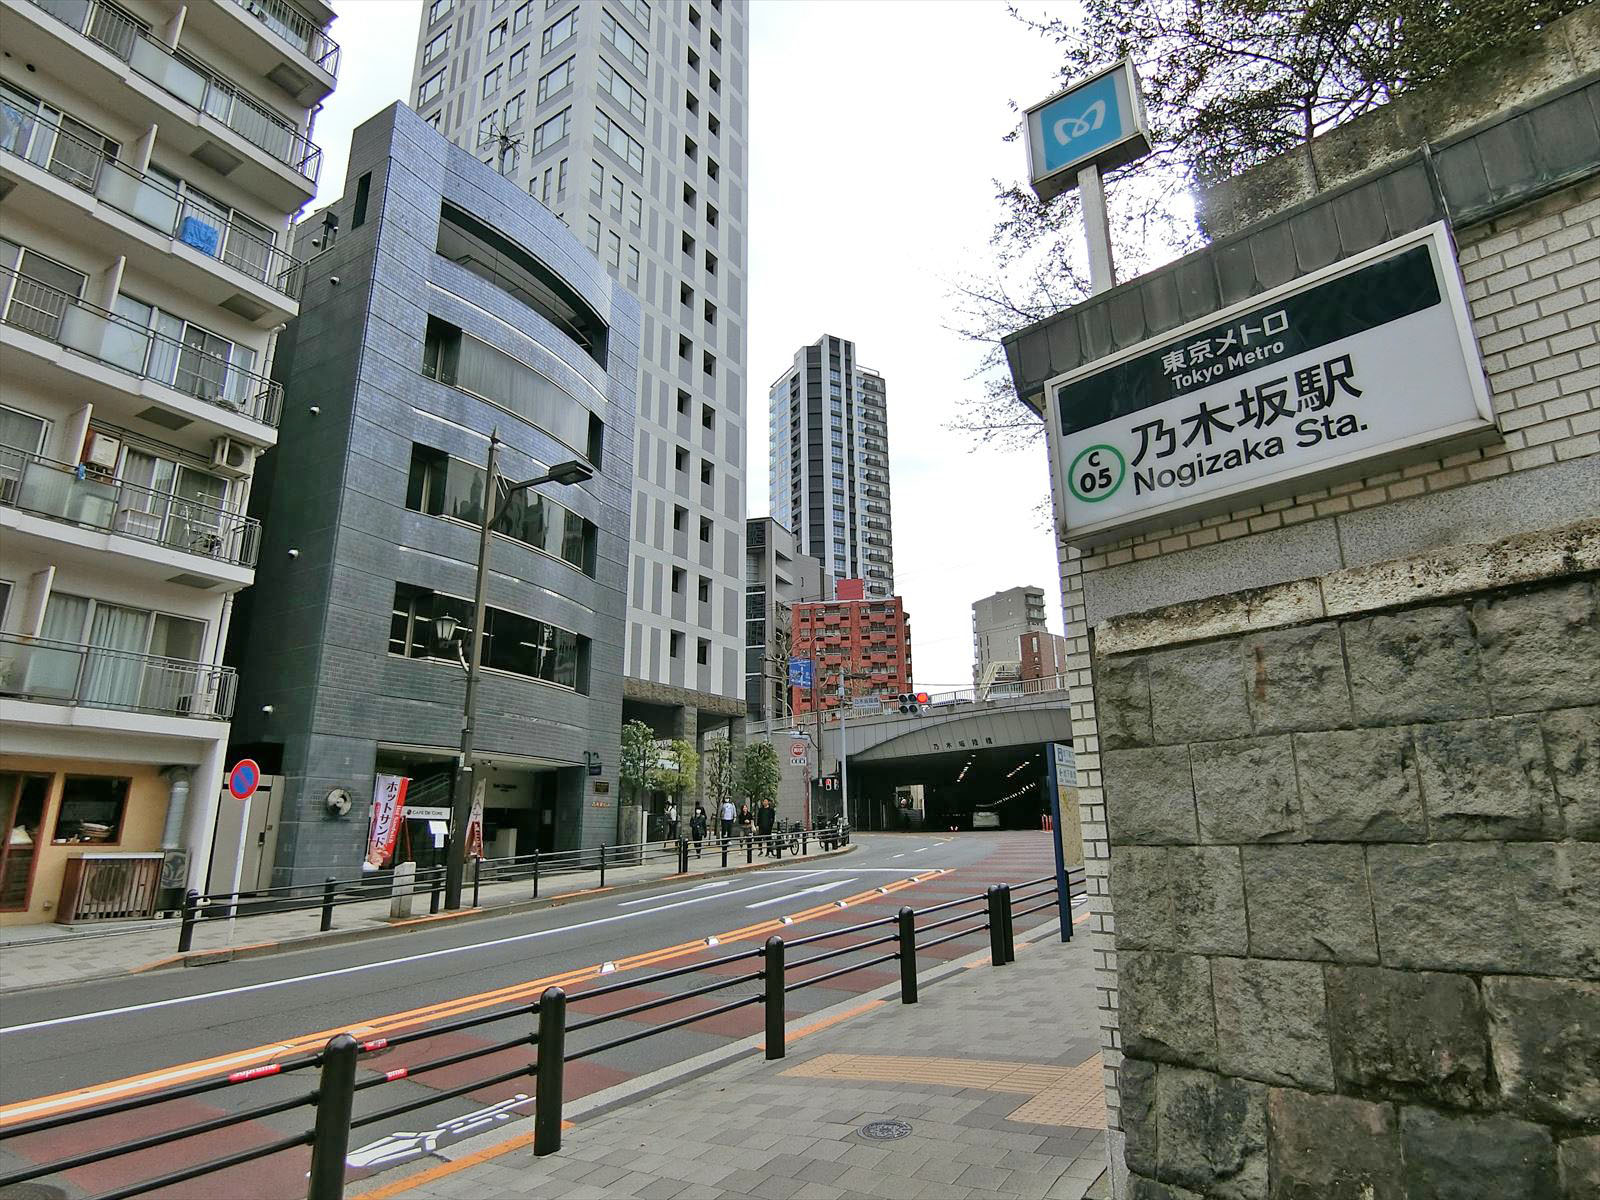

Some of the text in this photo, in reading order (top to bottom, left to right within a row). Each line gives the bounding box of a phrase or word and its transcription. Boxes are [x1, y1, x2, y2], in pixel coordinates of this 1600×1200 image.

[1161, 309, 1289, 375] 東京メトロ
[1170, 340, 1285, 391] Tokyo Metro
[1131, 353, 1363, 468] 乃木坂駅
[1079, 471, 1113, 494] 05
[1087, 451, 1101, 469] C
[1133, 410, 1368, 496] Nogizaka Sta.
[375, 781, 398, 847] ホットサンド
